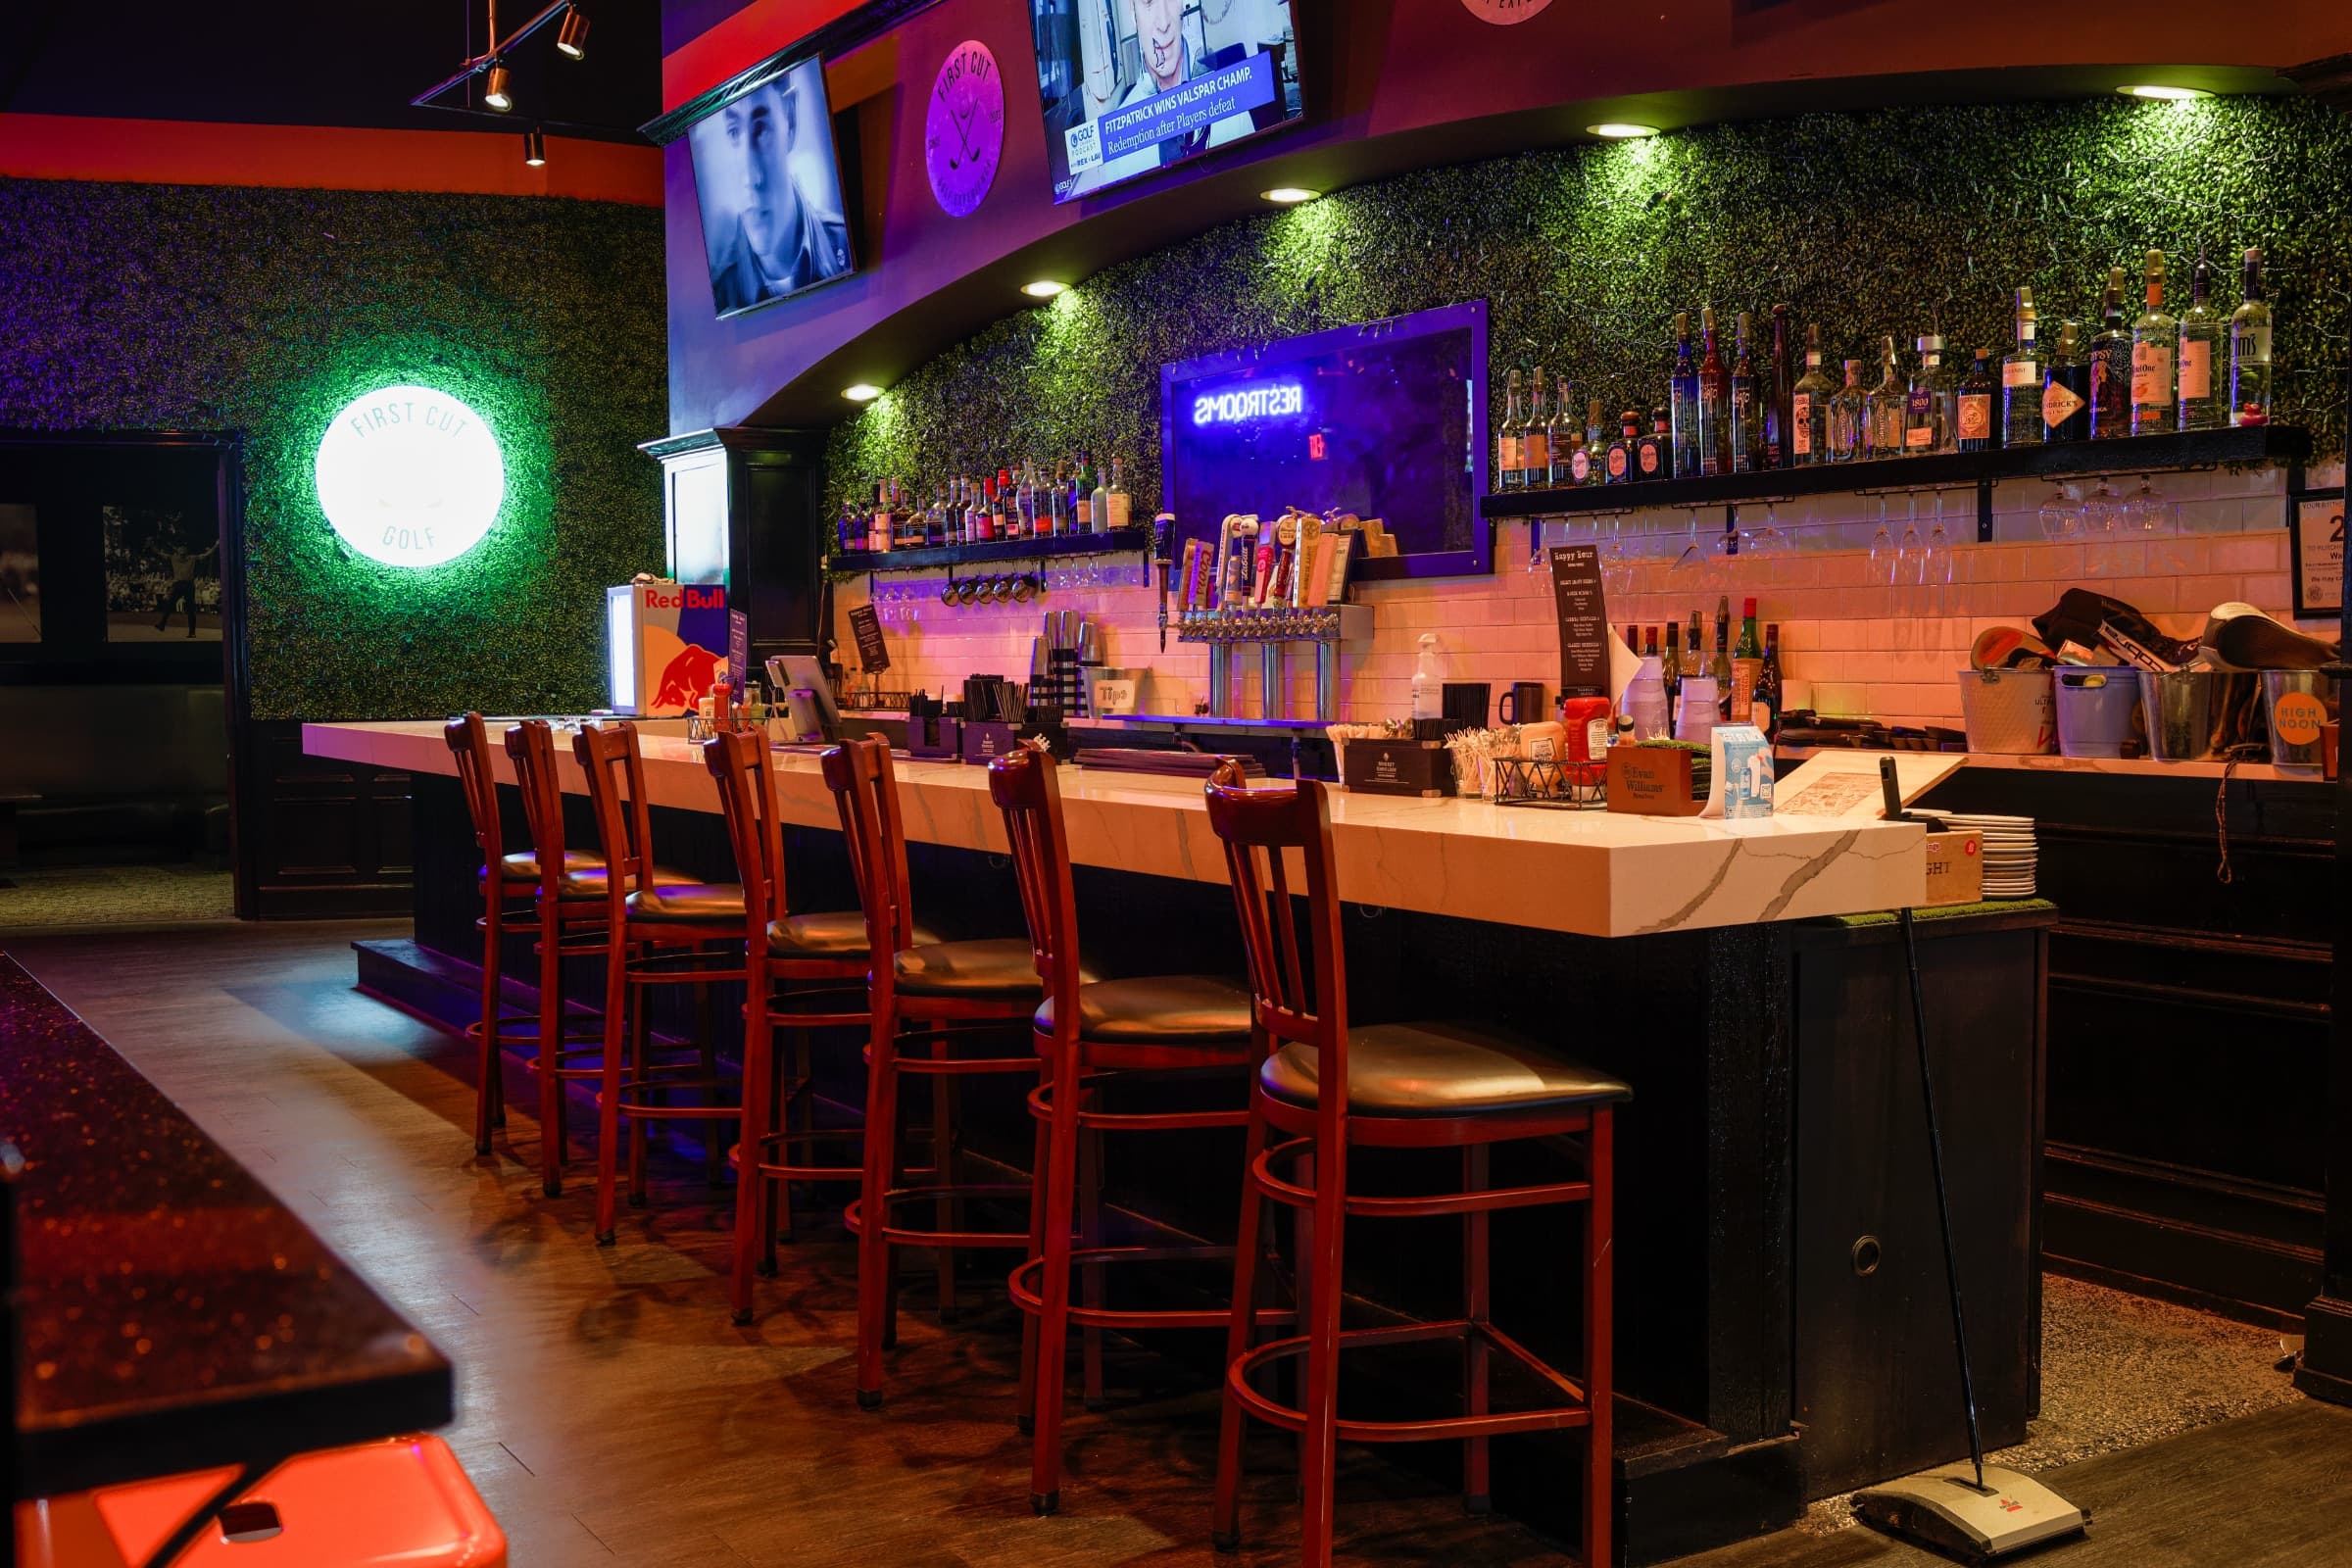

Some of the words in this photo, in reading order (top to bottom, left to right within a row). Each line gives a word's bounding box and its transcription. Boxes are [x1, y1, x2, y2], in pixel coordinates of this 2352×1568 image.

[937, 52, 967, 102] FIRST
[970, 51, 992, 80] CUT
[1104, 105, 1154, 135] FITZPATRICK
[1154, 95, 1177, 117] WINS
[1176, 81, 1216, 107] VALSPAR
[1216, 67, 1252, 91] CHAMP.
[1078, 124, 1095, 142] GOLF
[1107, 129, 1155, 156] Redemption
[1155, 121, 1176, 136] after
[1177, 110, 1207, 129] Players
[1208, 96, 1237, 118] defeat
[350, 402, 416, 439] FIRST
[425, 406, 468, 438] CUT
[382, 525, 436, 550] GOLF
[1554, 551, 1576, 562] Happy
[1577, 550, 1593, 559] Hour
[1197, 550, 1213, 595] Coors
[645, 588, 684, 609] Red
[686, 588, 725, 610] Bull
[1099, 686, 1128, 706] Tips
[2280, 707, 2317, 717] HIGH
[2279, 718, 2321, 729] NOON
[1631, 766, 1655, 779] Evan
[1626, 780, 1663, 793] Williams
